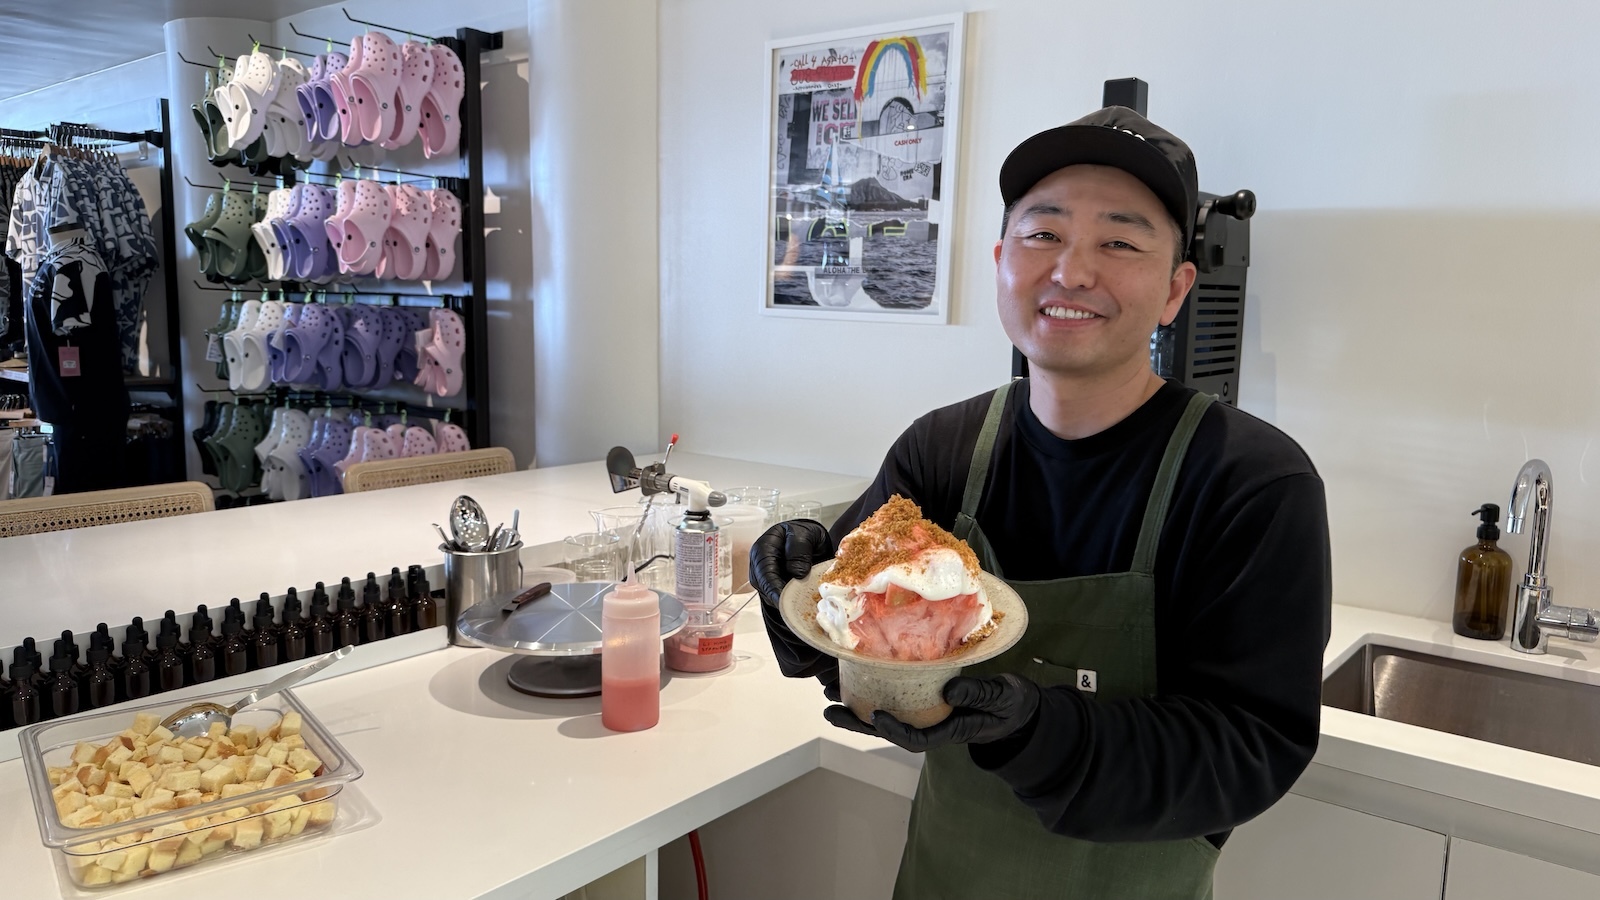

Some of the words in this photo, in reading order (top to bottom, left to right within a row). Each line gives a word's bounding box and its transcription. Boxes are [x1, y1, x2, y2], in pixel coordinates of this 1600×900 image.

[812, 100, 830, 122] WE
[908, 137, 922, 145] ONLY
[823, 266, 846, 274] ALOHA
[847, 266, 860, 274] THE
[1080, 674, 1092, 688] &
